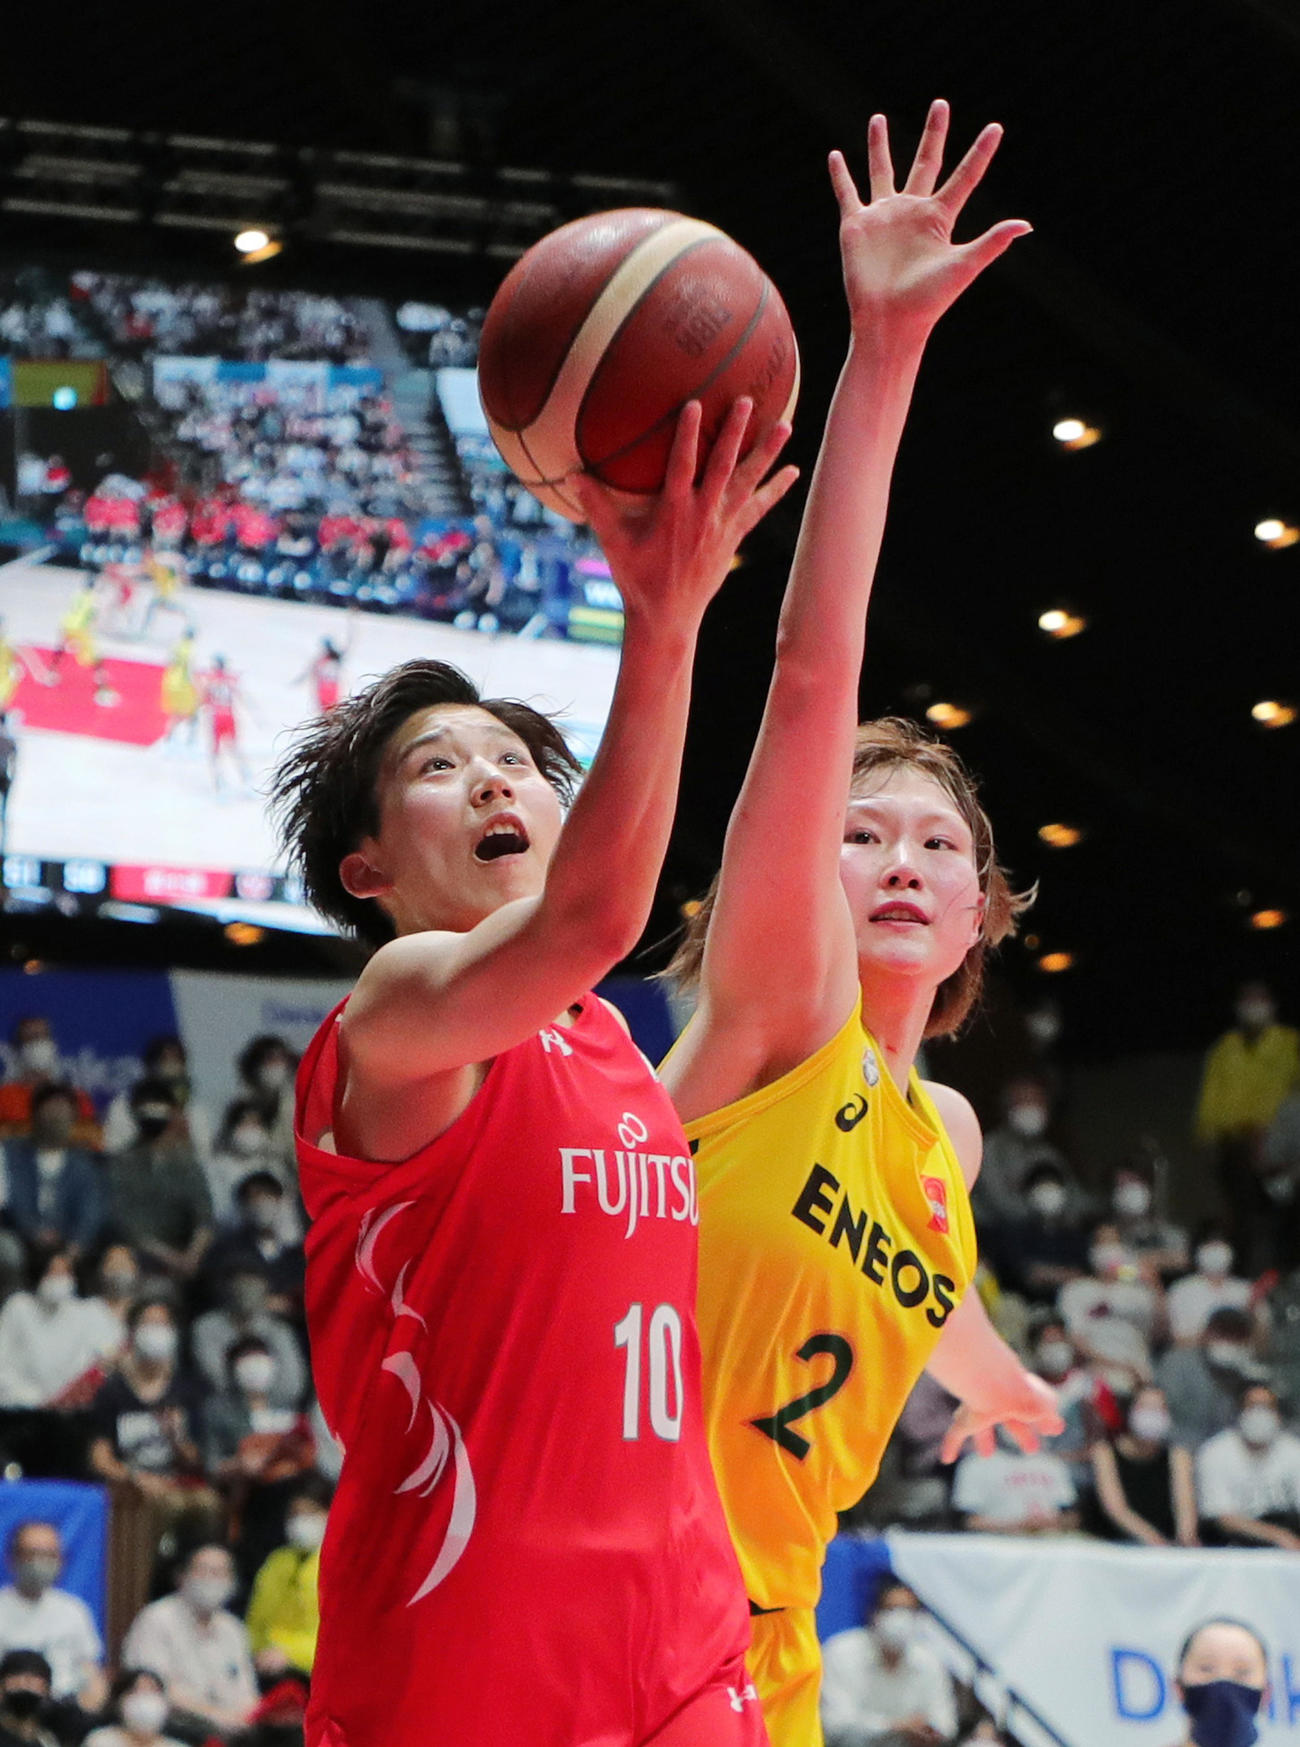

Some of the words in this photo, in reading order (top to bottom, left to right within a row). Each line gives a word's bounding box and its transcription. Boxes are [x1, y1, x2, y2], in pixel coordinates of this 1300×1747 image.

[558, 1147, 699, 1240] FUJITSU
[791, 1163, 955, 1329] ENEOS
[613, 1301, 684, 1442] 10
[747, 1332, 854, 1462] 2
